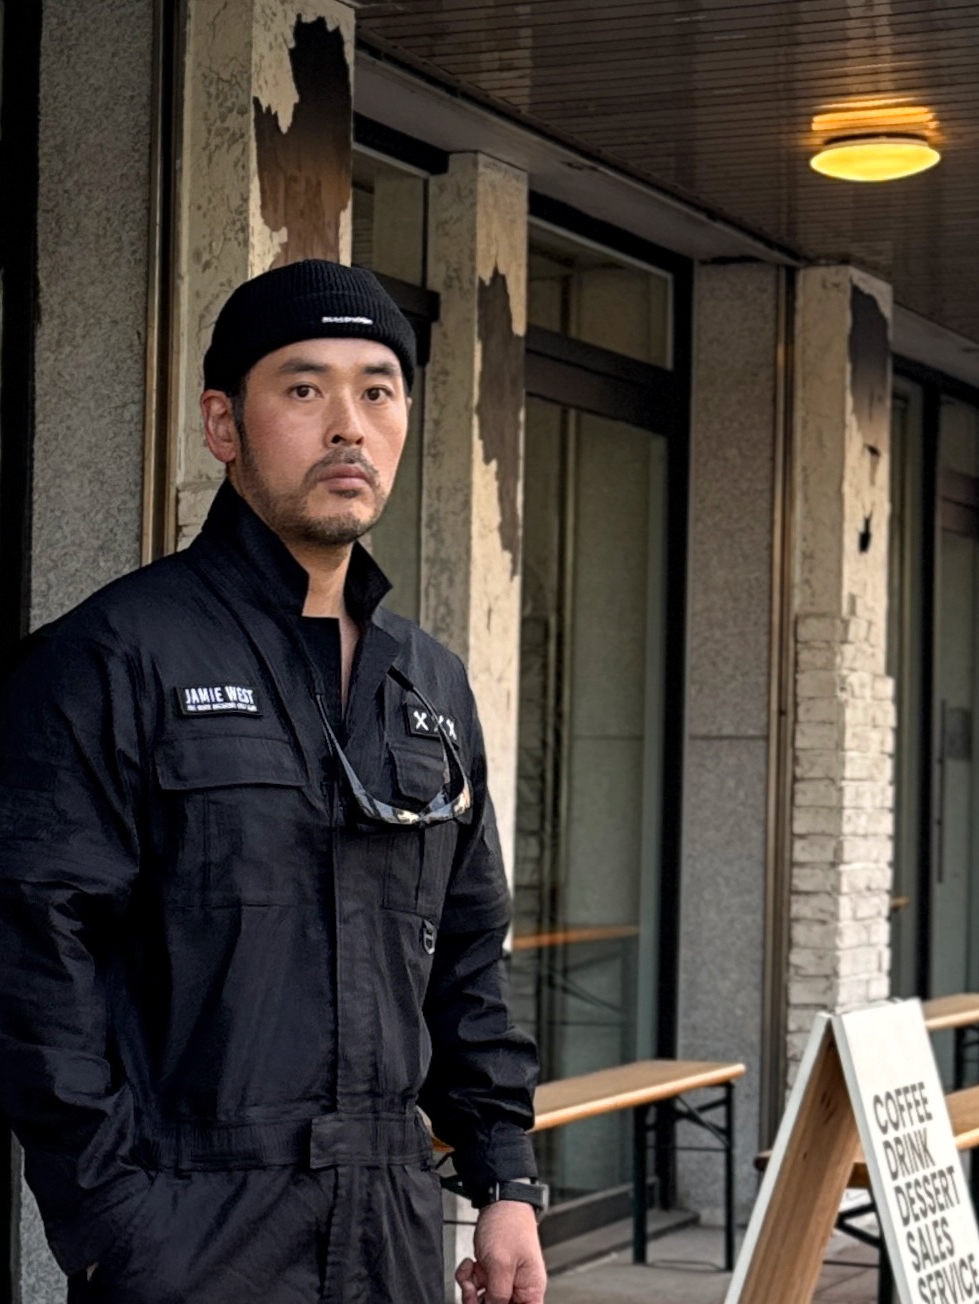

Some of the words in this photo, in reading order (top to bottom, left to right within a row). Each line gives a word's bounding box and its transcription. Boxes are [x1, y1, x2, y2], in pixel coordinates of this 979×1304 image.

[184, 686, 224, 704] JAMIE
[224, 684, 254, 704] WEST
[873, 1081, 933, 1135] COFFEE
[882, 1127, 936, 1181] DRINK
[893, 1165, 961, 1227] DESSERT
[906, 1216, 955, 1273] SALES
